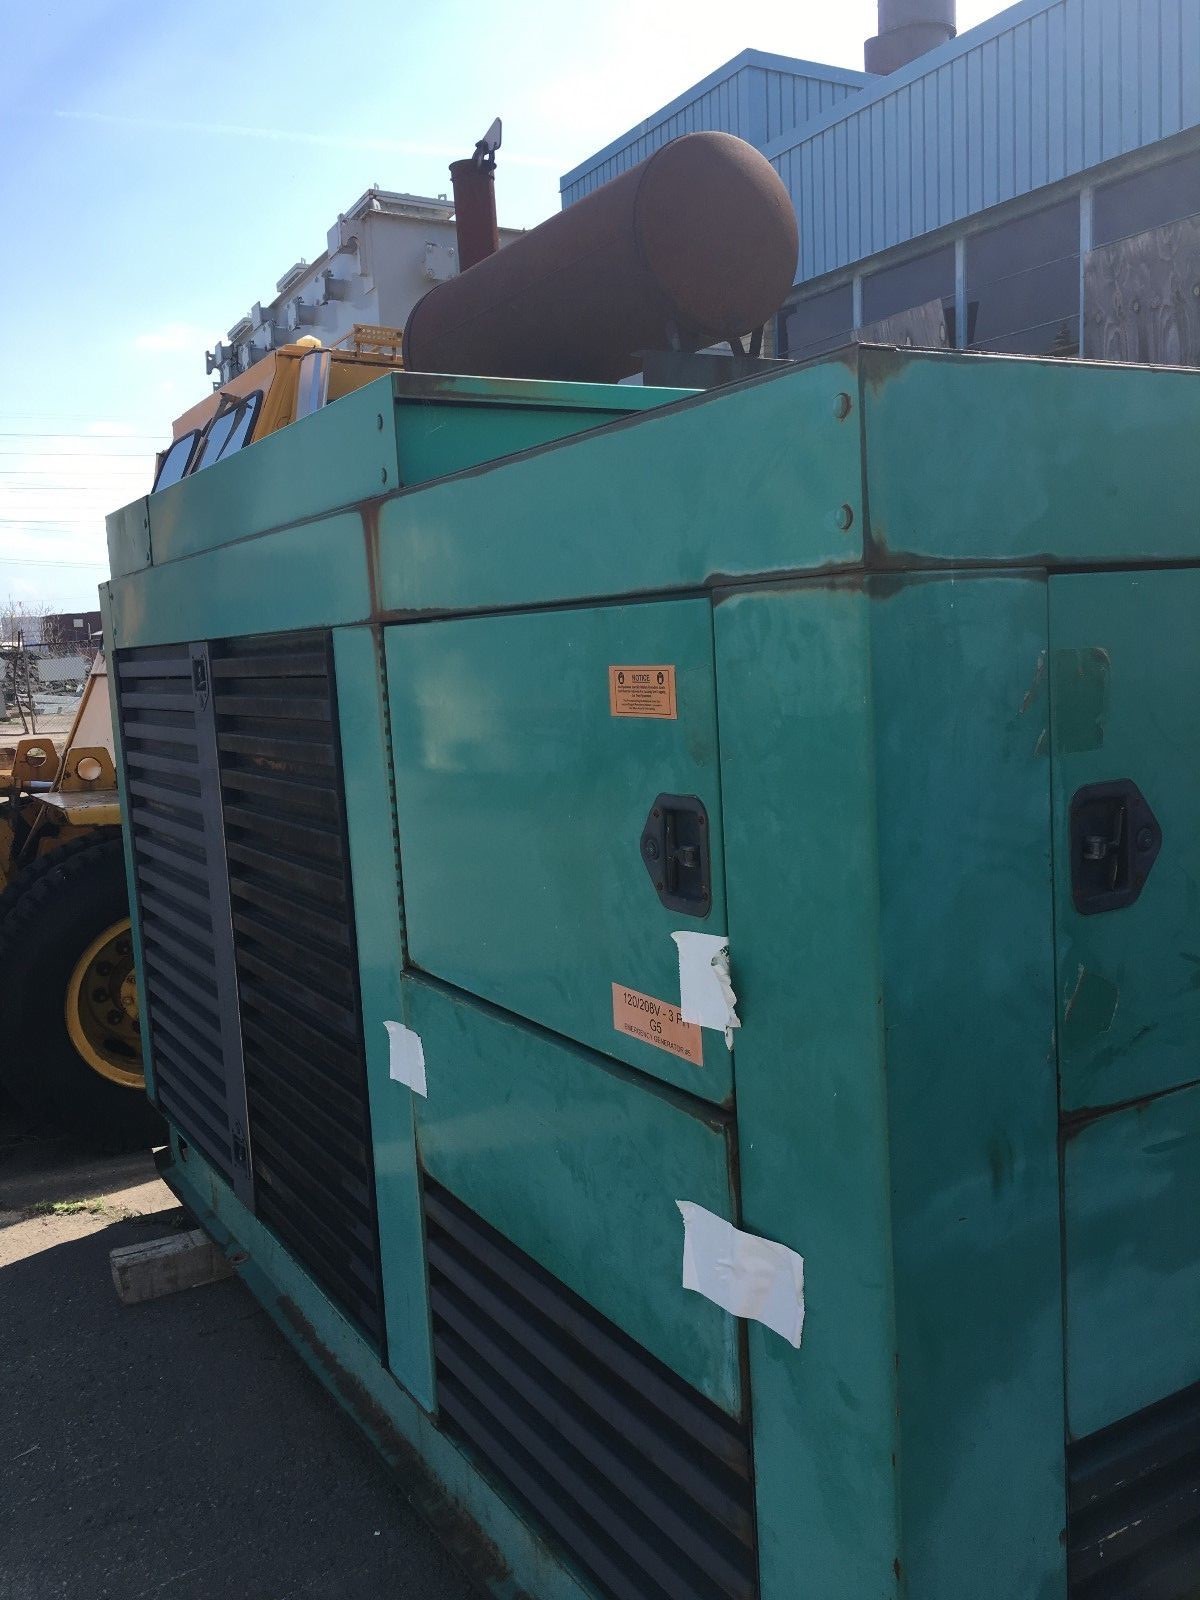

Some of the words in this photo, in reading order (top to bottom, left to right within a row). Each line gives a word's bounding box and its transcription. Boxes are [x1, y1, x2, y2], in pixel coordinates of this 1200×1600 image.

[631, 674, 651, 682] NOTICE
[623, 992, 660, 1016] 120/208V
[668, 1009, 674, 1022] 3
[624, 1022, 652, 1039] EMERGENCY
[653, 1036, 684, 1052] GENERATOR
[649, 1019, 662, 1034] G5
